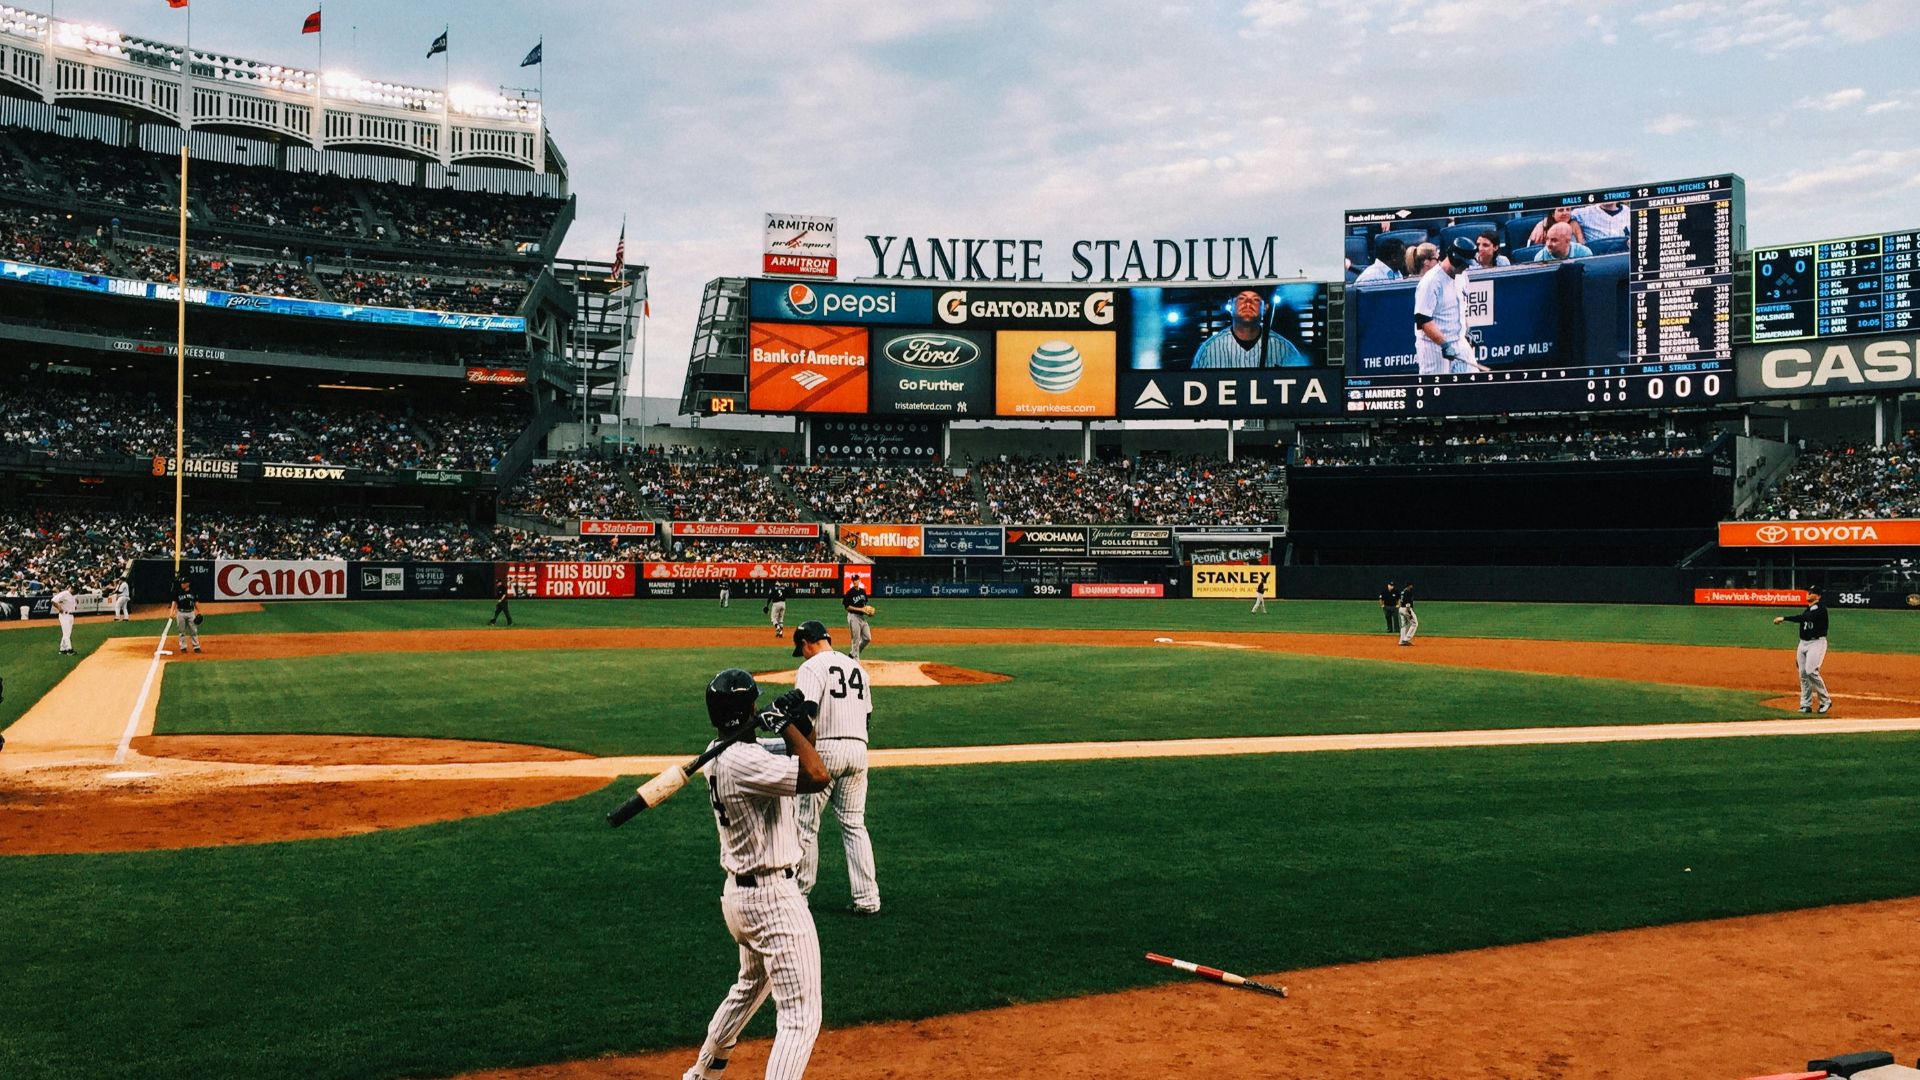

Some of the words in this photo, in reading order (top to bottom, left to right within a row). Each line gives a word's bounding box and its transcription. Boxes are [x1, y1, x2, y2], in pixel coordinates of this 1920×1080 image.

[1448, 207, 1467, 215] PITCH
[1468, 205, 1488, 214] SPEED
[1508, 202, 1524, 210] MPH
[1562, 196, 1582, 205] BALLS
[1588, 194, 1595, 203] 6
[1604, 191, 1631, 201] STRIKES
[1637, 188, 1649, 198] 12
[1656, 185, 1677, 195] TOTAL
[1678, 182, 1706, 193] PITCHES
[1707, 180, 1720, 189] 18
[1648, 198, 1675, 208] SEATTLE
[1676, 194, 1710, 205] MARINERS
[1659, 206, 1685, 215] MILLER
[1370, 213, 1396, 221] America
[1659, 213, 1687, 222] SEAGER
[767, 219, 834, 232] ARMITRON
[1659, 221, 1679, 229] CANO
[1659, 227, 1678, 236] CRUZ
[1659, 234, 1683, 243] SMITH
[1659, 241, 1691, 250] JACKSON
[1896, 243, 1911, 251] PHI
[1659, 248, 1686, 257] ACKLEY
[1759, 251, 1779, 261] LAD
[1789, 247, 1813, 258] WSH
[1830, 250, 1849, 258] WSH
[771, 256, 830, 268] ARMITRON
[864, 235, 1043, 282] YANKEE
[1071, 236, 1279, 282] STADIUM
[1659, 254, 1696, 264] MORRISON
[1896, 254, 1911, 262] CLE
[800, 266, 829, 274] WATCHES
[1659, 262, 1686, 270] ZUNINO
[1762, 264, 1772, 276] 0
[1795, 260, 1806, 273] 0
[1830, 261, 1846, 269] BAL
[1896, 261, 1911, 269] CIN
[1659, 269, 1706, 279] MONTGOMERY
[108, 279, 148, 297] BRIAN
[1647, 282, 1663, 290] NEW
[1664, 280, 1681, 289] YORK
[1682, 277, 1712, 287] YANKEES
[1830, 281, 1842, 289] KC
[1896, 281, 1911, 289] MIL
[1659, 289, 1695, 298] ELLSBURY
[1830, 288, 1849, 296] CHW
[823, 291, 896, 317] pepsi
[938, 290, 967, 324] G
[971, 301, 1081, 318] GATORADE
[1084, 291, 1114, 325] G
[1858, 300, 1878, 308] 8:15
[437, 313, 458, 326] New
[459, 315, 480, 330] York
[482, 317, 521, 330] Yankees
[1755, 312, 1795, 322] BOLSINGER
[1831, 318, 1847, 326] MIN
[1659, 325, 1684, 333] YOUNG
[1830, 325, 1848, 333] OAK
[1659, 331, 1691, 340] HEADLEY
[168, 346, 204, 358] YAKEES
[205, 350, 225, 360] CLUB
[902, 338, 960, 364] Ford
[1491, 344, 1511, 358] CAP
[1513, 343, 1525, 355] OF
[753, 348, 790, 363] Bank
[791, 349, 806, 363] of
[807, 350, 865, 366] America
[1363, 357, 1382, 369] THE
[1384, 353, 1418, 367] OFFICIA
[1659, 354, 1688, 362] TANAKA
[1643, 365, 1663, 373] BALLS
[1669, 363, 1697, 372] STRIKES
[1701, 361, 1720, 370] OUTS
[467, 370, 527, 383] Budweiser
[899, 379, 917, 391] Go
[919, 379, 964, 391] Further
[1648, 377, 1664, 399] 0
[1675, 376, 1691, 398] 0
[1704, 374, 1720, 396] 0
[1183, 378, 1328, 406] DELTA
[1364, 389, 1407, 399] MARINERS
[895, 402, 952, 411] tristateford.com
[1015, 402, 1096, 414] att.yankees.com
[1365, 400, 1406, 410] YANKEES
[167, 458, 239, 474] SRACUSE
[416, 471, 439, 480] Poland
[440, 471, 462, 483] Spring
[1025, 532, 1084, 542] YOKOHAMA
[1091, 527, 1126, 542] Yankees
[1131, 531, 1169, 539] STEINER
[1791, 526, 1878, 541] TOYOTA
[860, 532, 920, 549] DraftKings
[1190, 551, 1226, 563] Peanut
[1228, 548, 1263, 561] Chews
[545, 564, 579, 579] THIS
[582, 564, 625, 579] BUD'S
[217, 564, 345, 597] Canon
[1197, 571, 1270, 584] STANLEY
[546, 580, 574, 596] FOR
[895, 587, 922, 595] Experian
[941, 586, 969, 595] Experian
[990, 586, 1018, 595] Experian
[1085, 586, 1120, 594] DUNKIN'
[1120, 586, 1156, 594] DONUTS
[34, 599, 50, 609] ACC
[828, 666, 864, 701] 34
